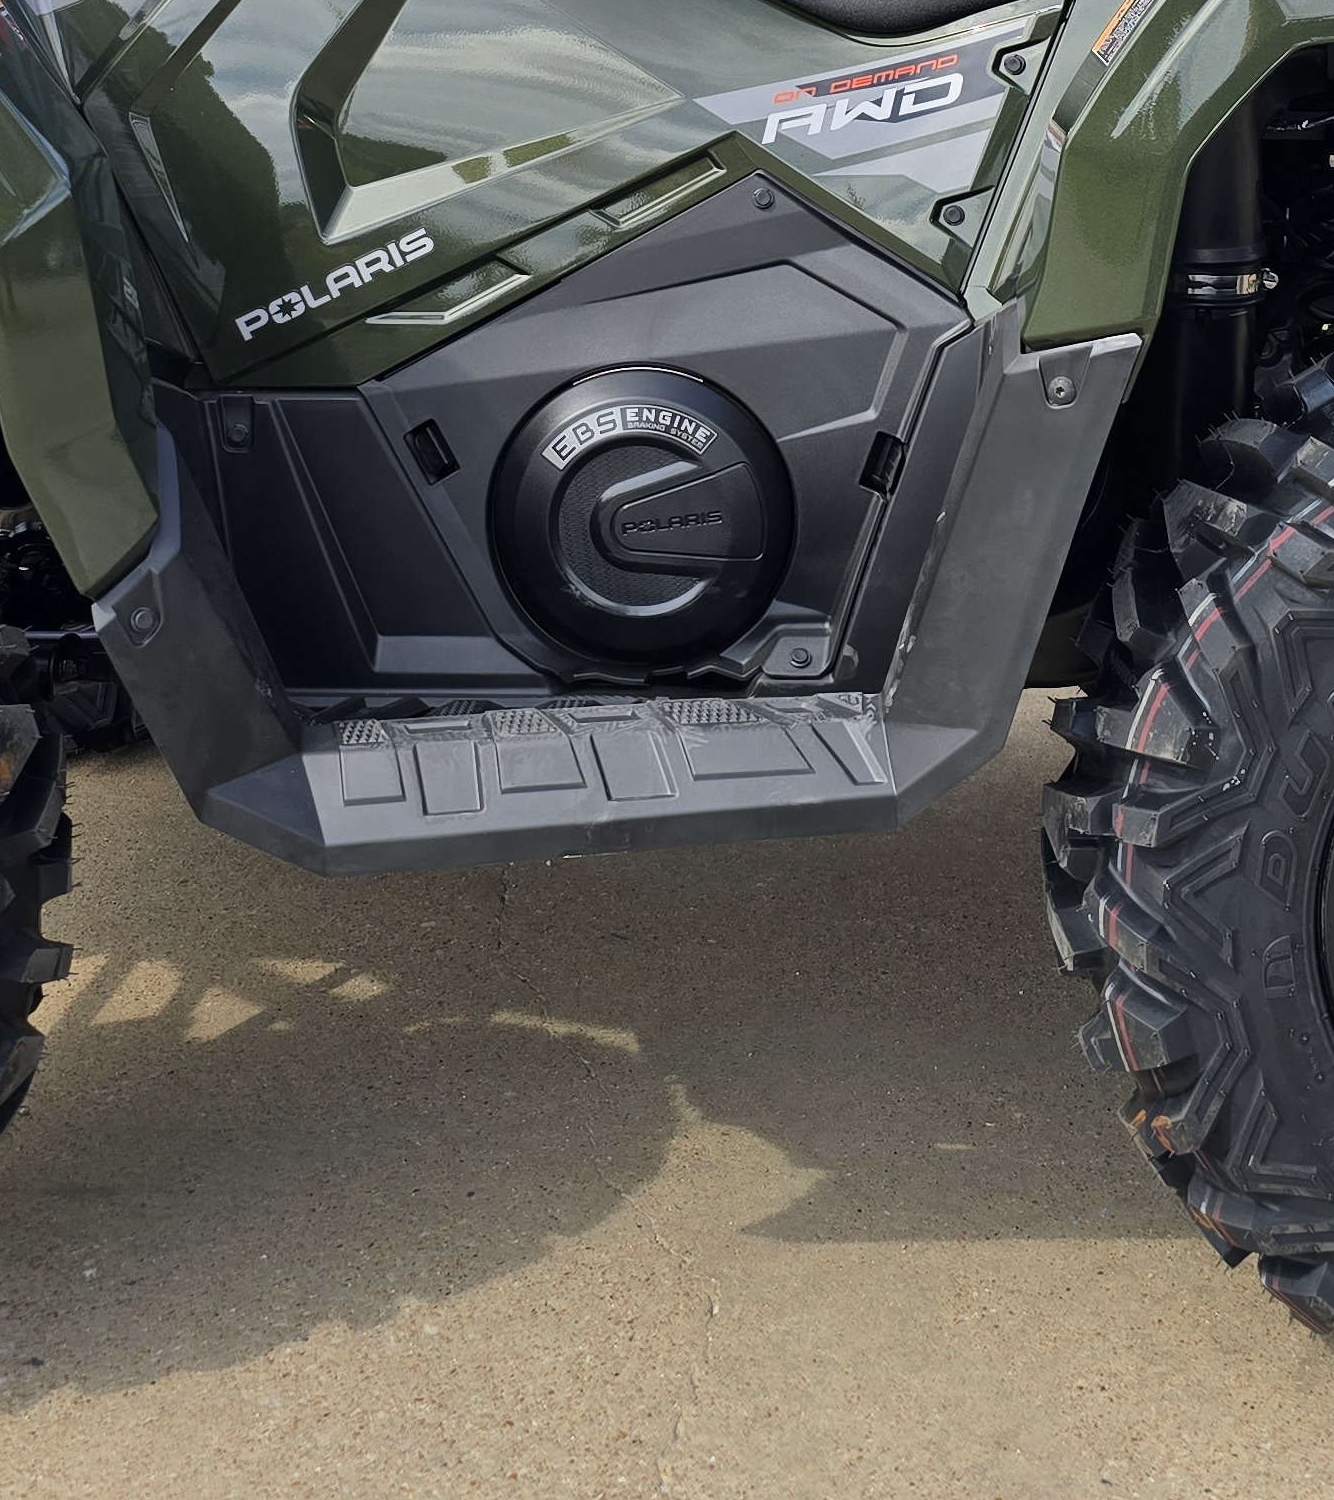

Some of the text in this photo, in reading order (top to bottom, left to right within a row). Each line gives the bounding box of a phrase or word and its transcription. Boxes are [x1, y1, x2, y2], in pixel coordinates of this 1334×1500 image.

[773, 54, 958, 104] ON DEMAND
[761, 72, 964, 145] AWD
[234, 227, 435, 342] POLARIS
[551, 407, 711, 462] EBS ENGINE
[627, 421, 704, 449] BRAKING SYSTEM
[621, 510, 723, 537] POLARIS
